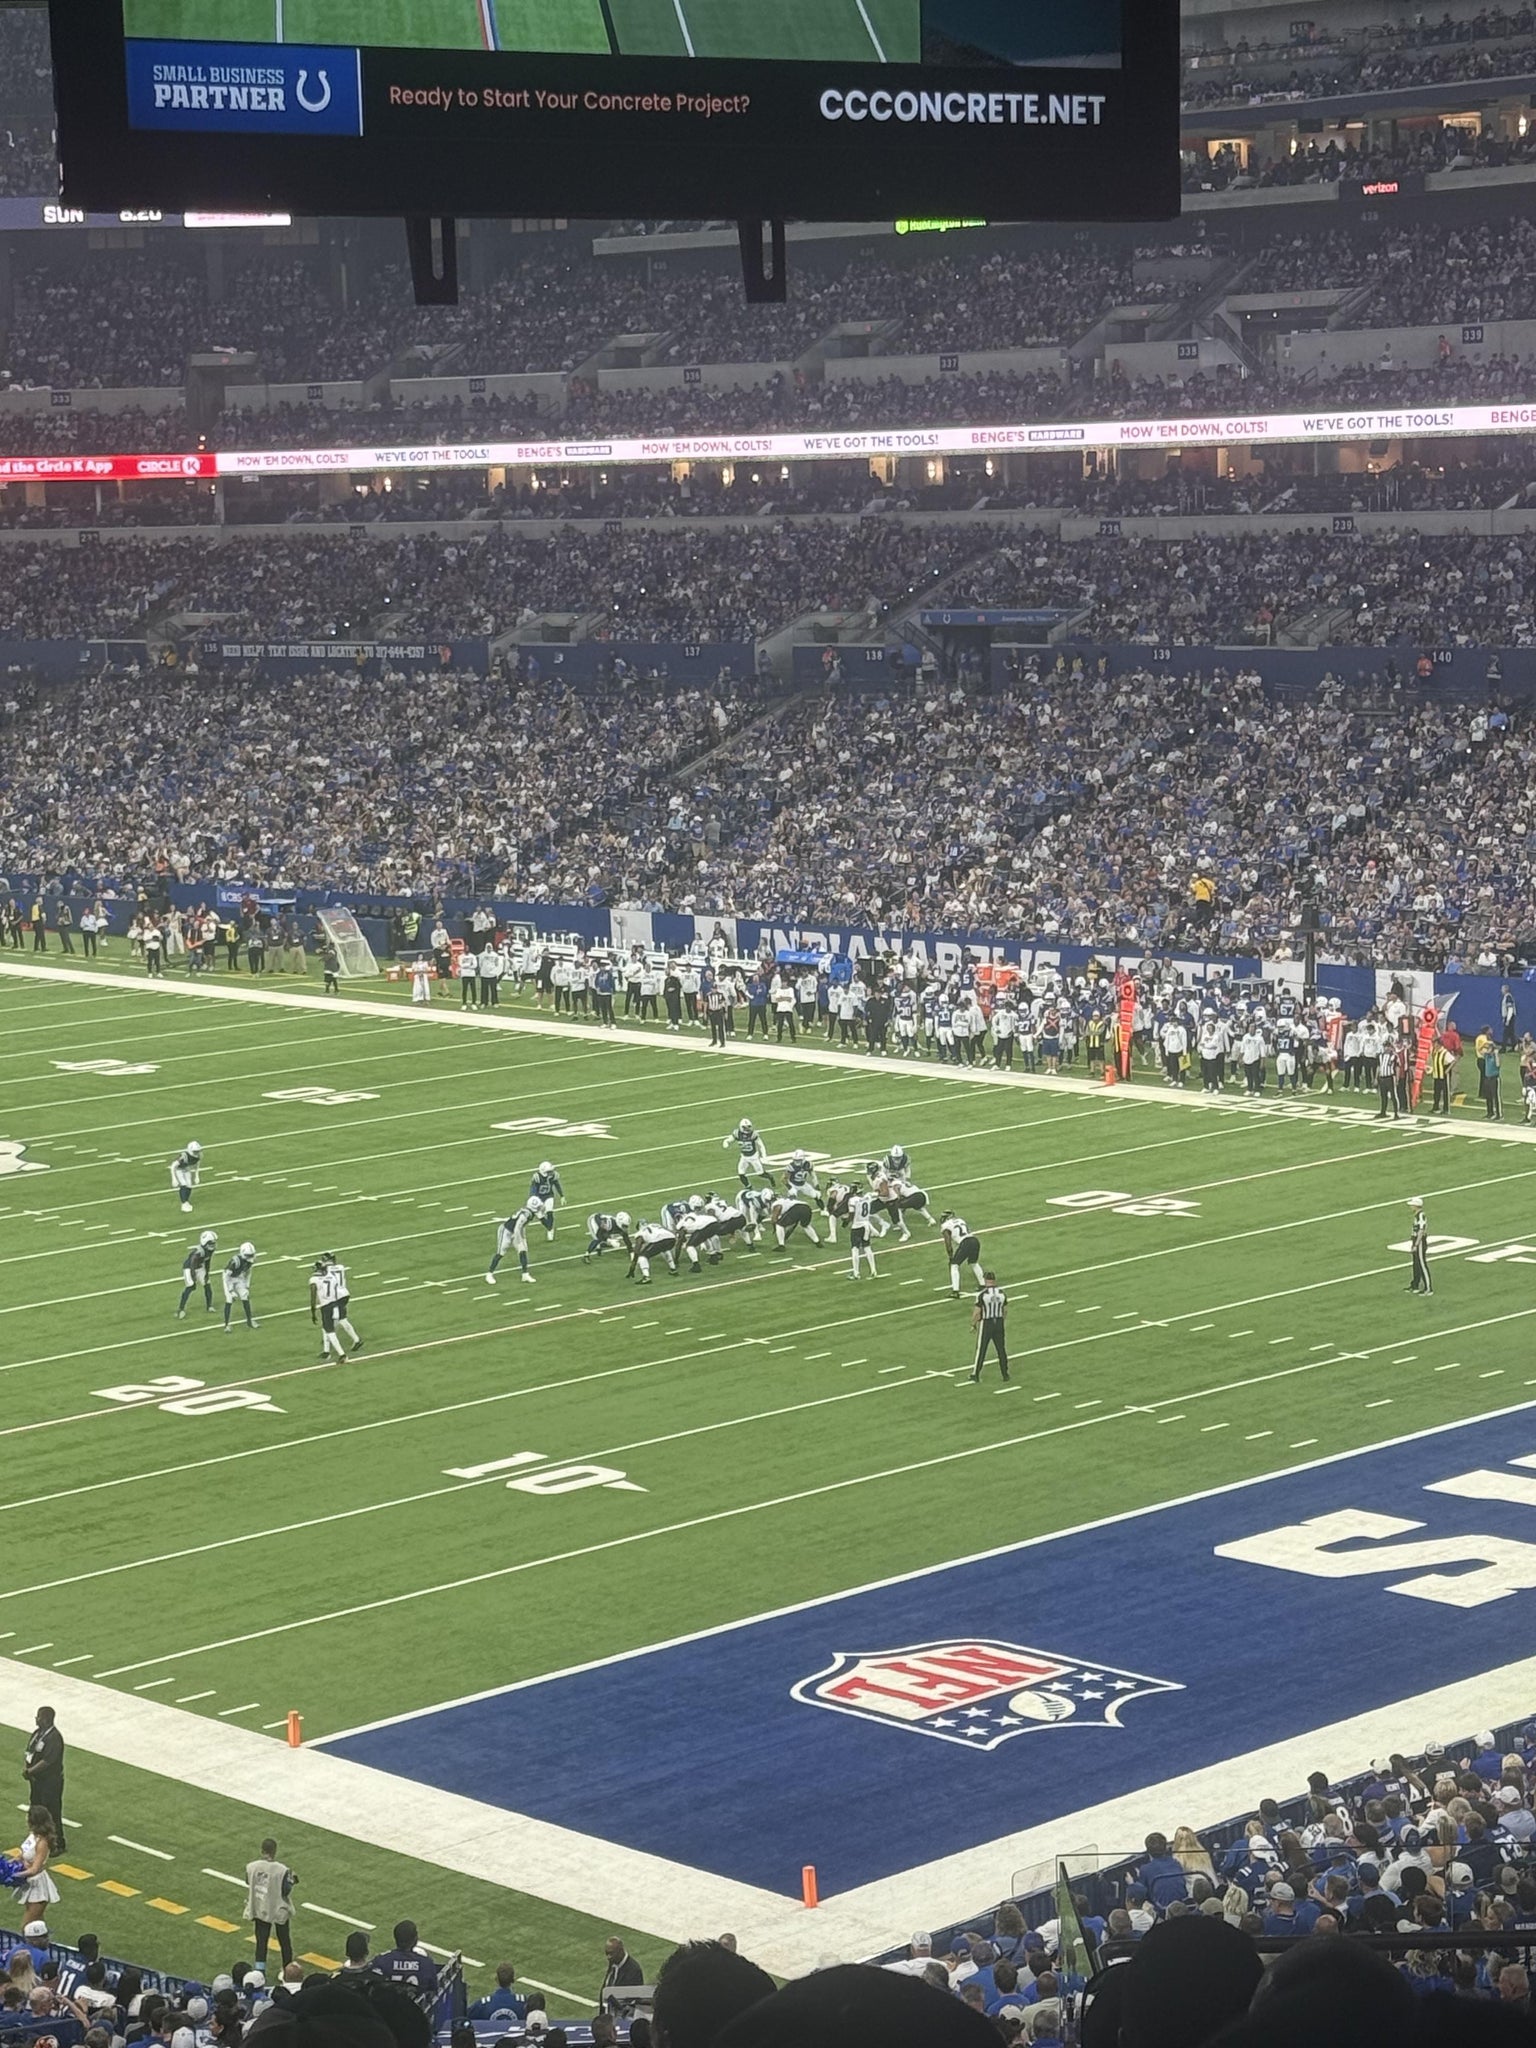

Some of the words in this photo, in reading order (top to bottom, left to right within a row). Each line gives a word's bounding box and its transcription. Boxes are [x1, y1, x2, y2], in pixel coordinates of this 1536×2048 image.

[153, 65, 207, 83] SMALL
[209, 67, 285, 85] BUSINESS
[153, 84, 287, 112] PARTNER
[389, 86, 453, 111] Ready
[457, 88, 478, 107] to
[483, 89, 530, 109] Start
[534, 90, 578, 109] Your
[583, 91, 672, 112] Concrete
[676, 93, 751, 118] Project?
[819, 88, 1107, 126] CCCONCRETE.NET
[1362, 181, 1398, 195] verizon
[43, 206, 84, 223] SUN
[1463, 329, 1482, 341] 339
[1179, 346, 1197, 357] 338
[941, 358, 957, 370] 337
[1120, 425, 1153, 438] MOW
[1156, 424, 1180, 437] 'EM
[1181, 423, 1224, 437] DOWN,
[1225, 421, 1269, 435] COLTS!
[1302, 418, 1345, 432] WE'VE
[1347, 417, 1376, 430] GOT
[1377, 415, 1404, 428] THE
[1405, 413, 1454, 427] TOOLS!
[803, 437, 841, 450] WE'VE
[843, 436, 869, 448] GOT
[871, 435, 894, 447] THE
[896, 434, 940, 446] TOOLS!
[971, 431, 1026, 443] BENGE'S
[517, 447, 563, 458] BENGE'S
[641, 443, 670, 454] MOW
[692, 441, 733, 453] DOWN,
[734, 439, 773, 451] COLTS!
[408, 450, 430, 462] GOT
[431, 450, 452, 461] THE
[453, 449, 490, 460] TOOLS!
[12, 462, 35, 473] the
[36, 461, 72, 473] Circle
[73, 461, 84, 472] K
[85, 461, 113, 474] App
[137, 460, 181, 473] CIRCLE
[1334, 519, 1353, 531] 239
[684, 646, 701, 657] 137
[865, 649, 883, 661] 138
[1152, 648, 1171, 661] 139
[1432, 651, 1452, 663] 140
[90, 1376, 272, 1415] 20
[441, 1451, 628, 1495] 10
[826, 1647, 1059, 1711] NFL
[56, 1970, 77, 1997] 11
